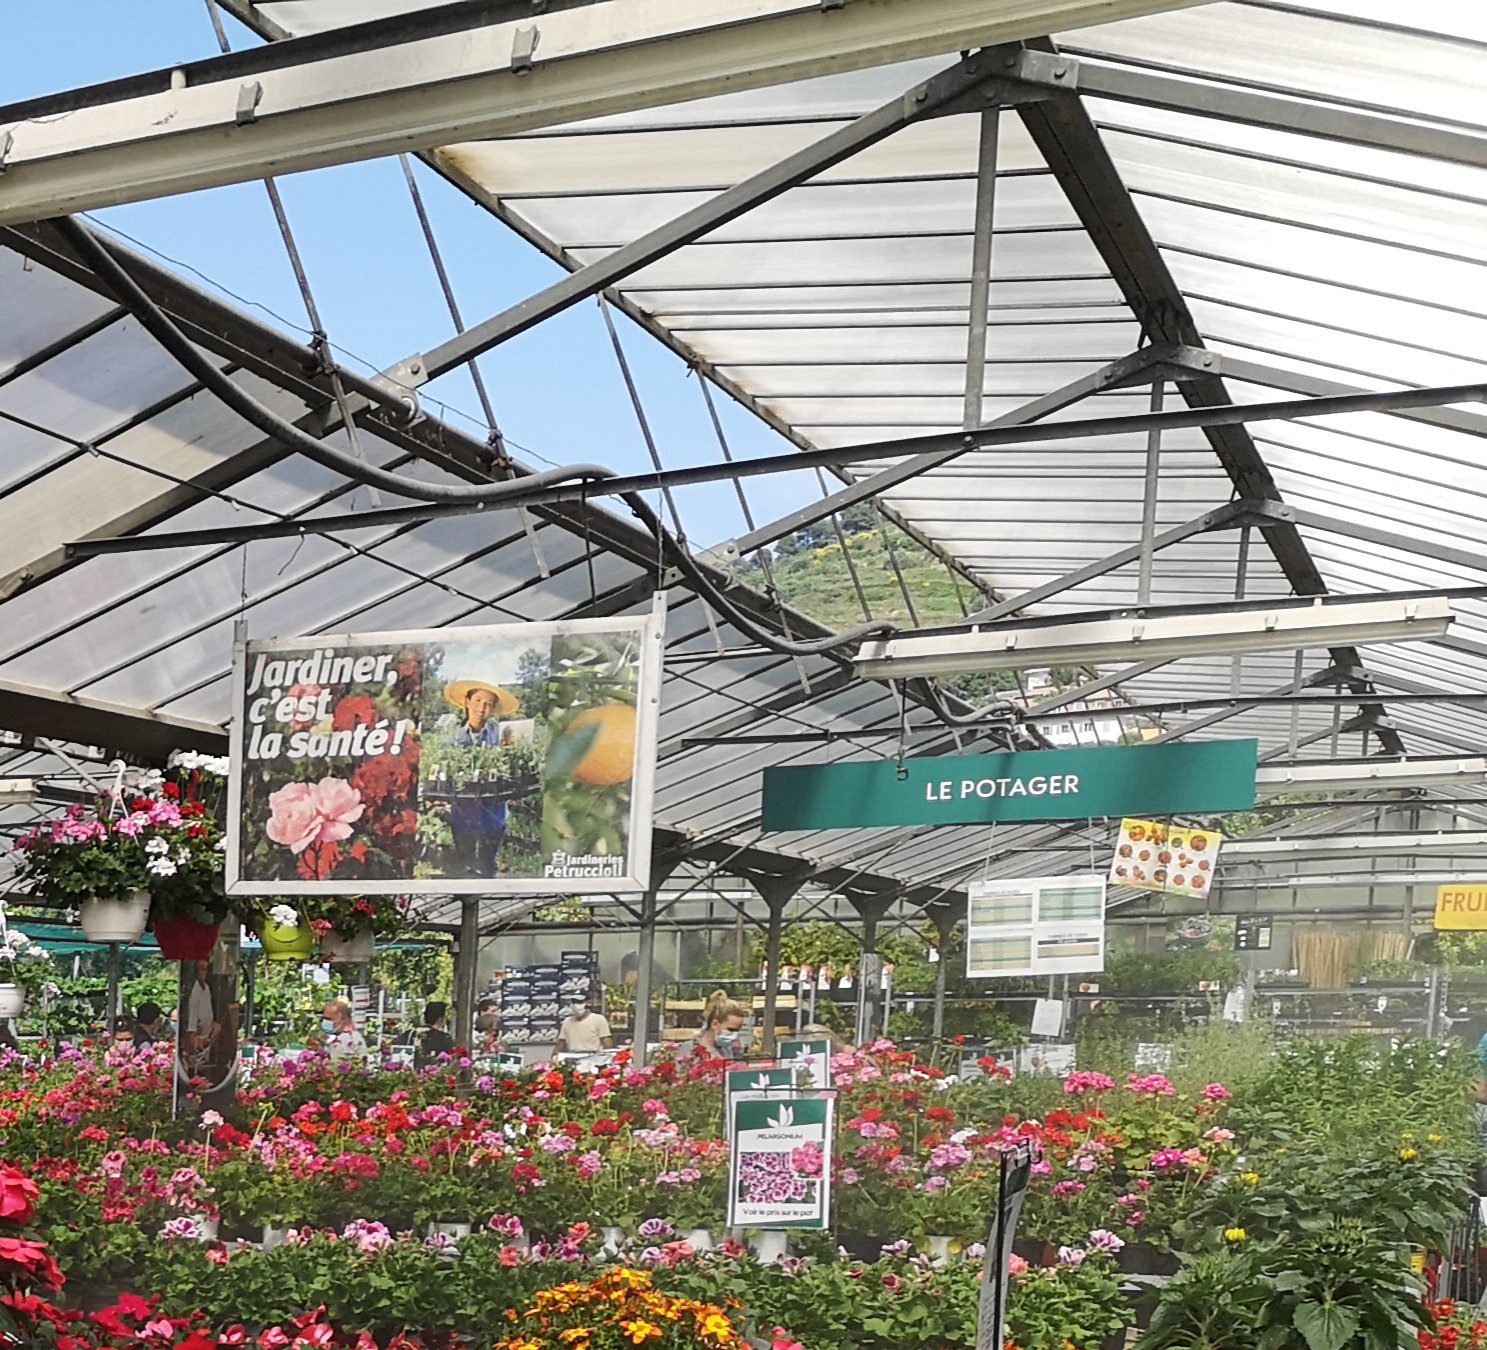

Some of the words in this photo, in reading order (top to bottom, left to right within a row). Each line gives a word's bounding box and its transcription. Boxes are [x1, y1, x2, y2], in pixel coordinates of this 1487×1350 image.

[246, 648, 398, 696] Jardiner,
[249, 688, 332, 724] c'est
[247, 724, 283, 759] la
[926, 781, 953, 801] LE
[960, 774, 1080, 799] POTAGER
[544, 863, 623, 878] Petruccioli
[566, 854, 624, 866] Jardineries
[743, 1208, 757, 1216] Voir
[766, 1209, 780, 1217] prix
[800, 1209, 813, 1217] pot
